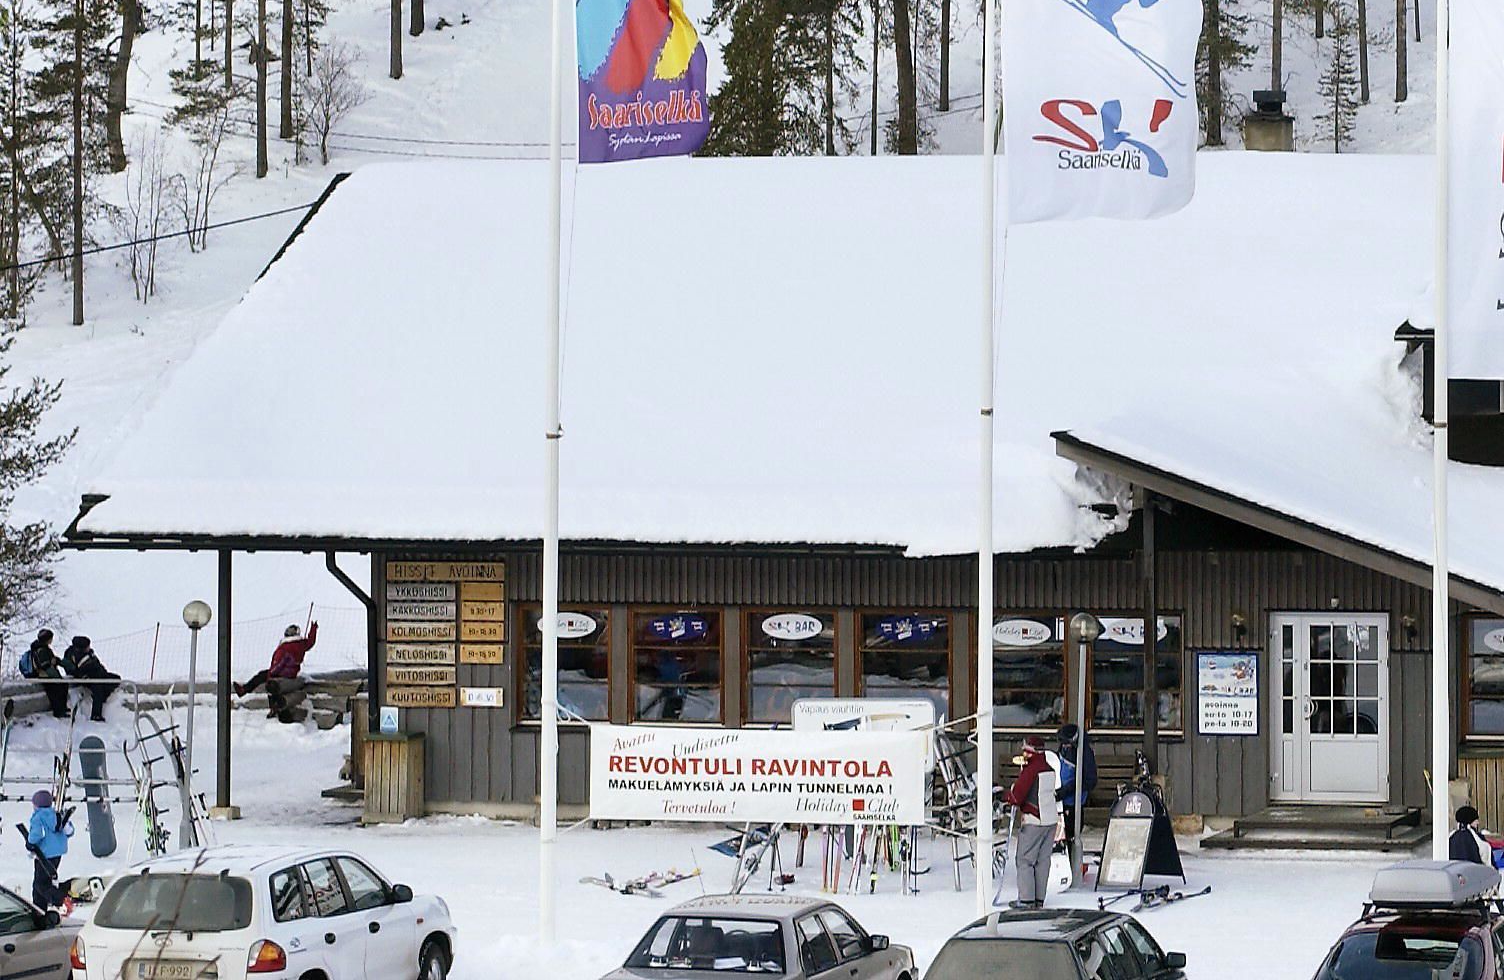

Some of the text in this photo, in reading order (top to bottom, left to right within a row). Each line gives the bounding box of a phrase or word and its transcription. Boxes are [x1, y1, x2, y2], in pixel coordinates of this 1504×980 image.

[587, 89, 704, 131] Saariselkä
[1057, 149, 1142, 170] Saariselkä
[449, 564, 497, 579] AVOINNA
[391, 626, 451, 638] KOLMOSHISSI
[395, 647, 448, 660] NELOSHISSI
[394, 670, 449, 682] VIITOSHISSI
[391, 691, 451, 703] KUUTOSHISSI
[613, 731, 656, 754] Avattu
[671, 732, 740, 758] Uudistettu
[608, 755, 894, 779] REVONTULI RAVINTOLA
[608, 778, 725, 792] MAKUELÄMYKSIÄ
[729, 781, 746, 793] JA
[751, 782, 792, 794] LAPIN
[796, 783, 885, 795] TUNNELMAA
[661, 798, 728, 815] Tervetuloa
[795, 797, 900, 814] Holiday Club
